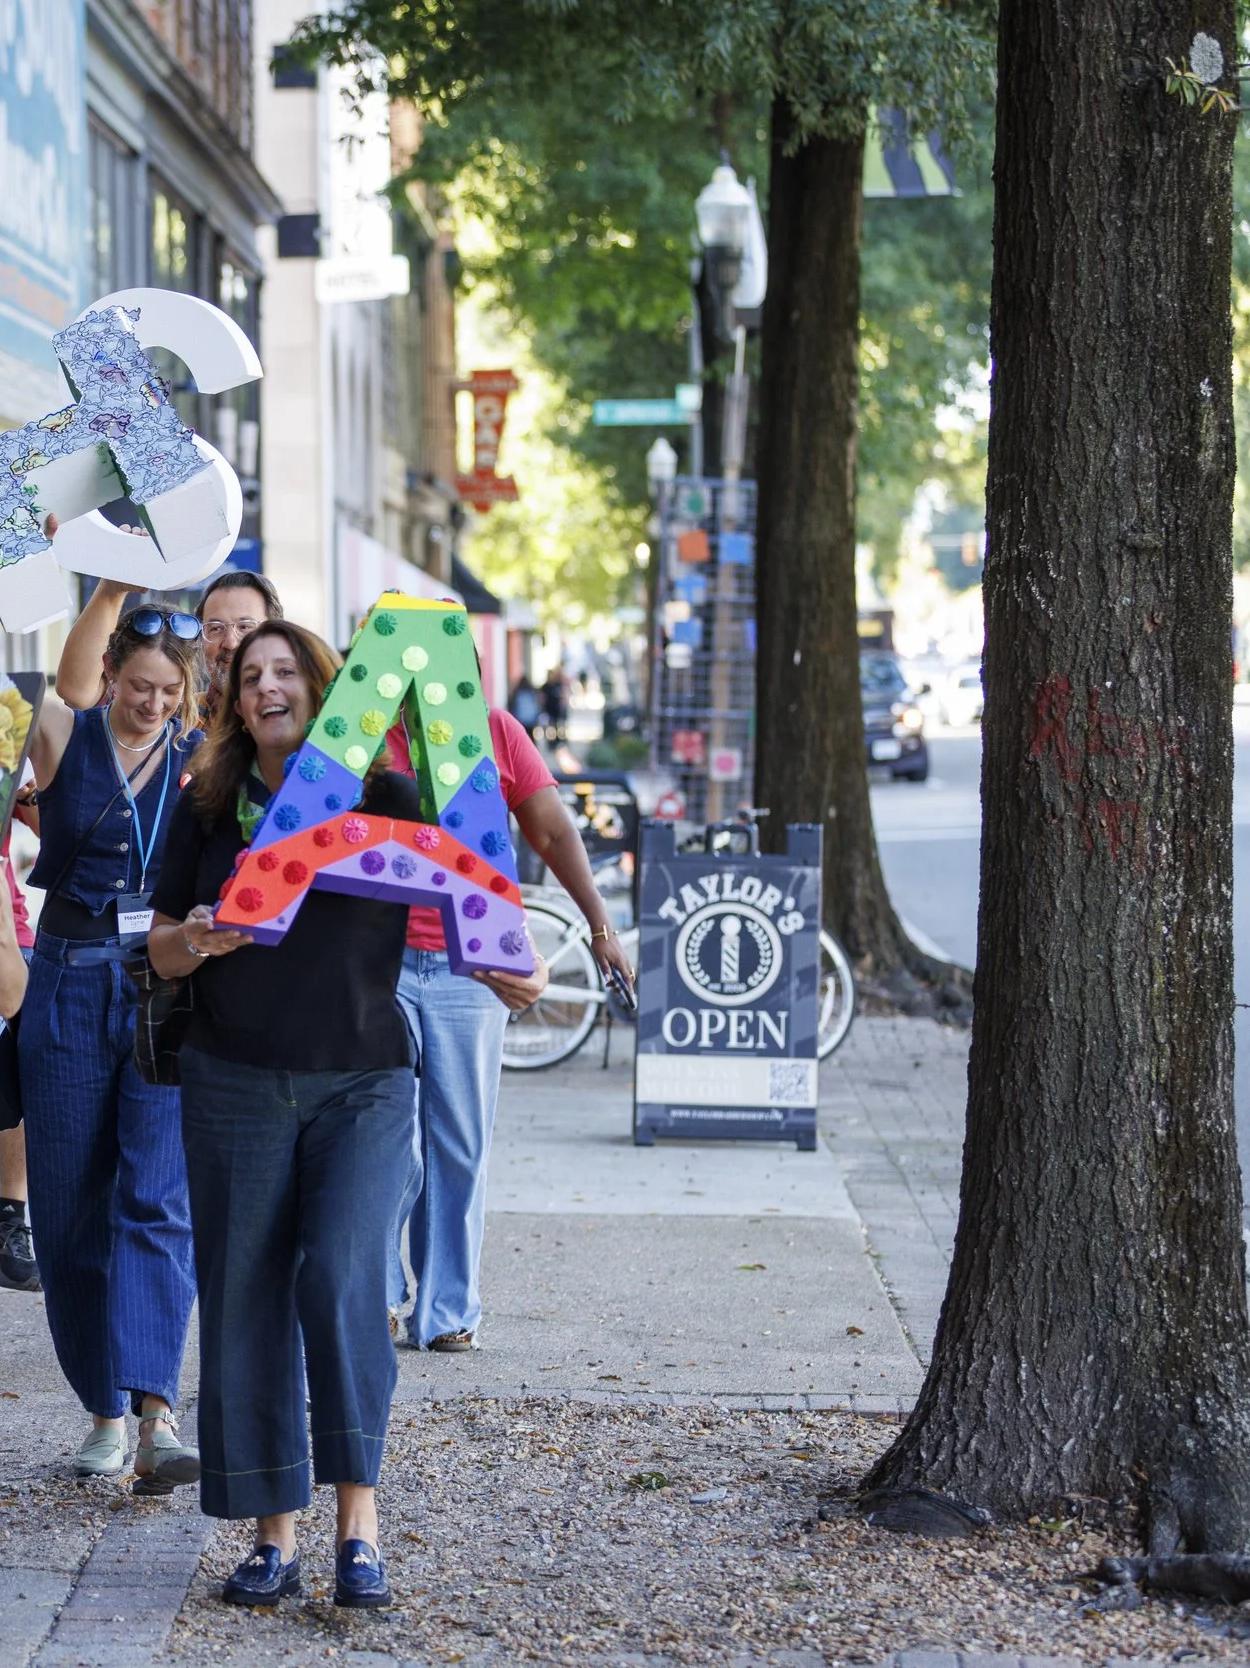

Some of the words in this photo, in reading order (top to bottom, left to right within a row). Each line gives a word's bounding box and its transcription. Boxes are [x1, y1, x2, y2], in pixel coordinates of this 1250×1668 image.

[214, 593, 536, 977] A
[124, 913, 151, 921] Heather
[658, 873, 805, 935] TAYLOR'S
[662, 1007, 789, 1049] OPEN
